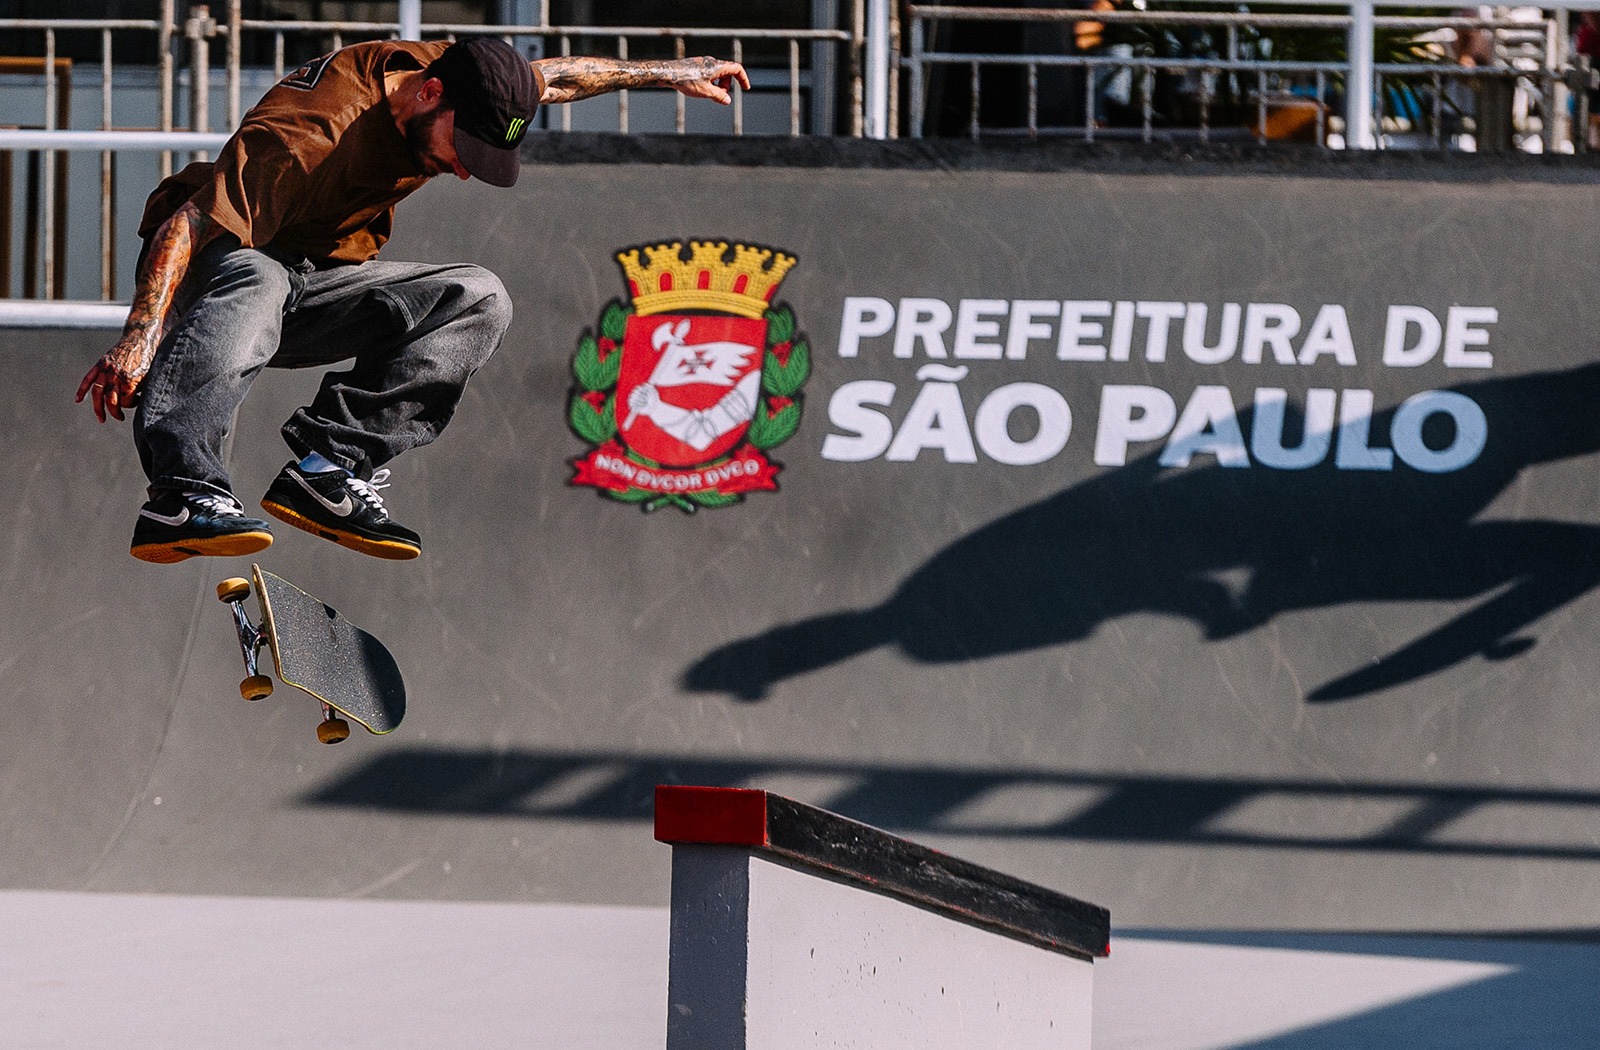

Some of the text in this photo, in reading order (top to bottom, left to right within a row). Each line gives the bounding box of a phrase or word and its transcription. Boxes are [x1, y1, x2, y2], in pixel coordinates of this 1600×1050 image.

[838, 297, 1499, 368] PREFEITURA DE
[821, 364, 1488, 473] SÃO PAULO
[595, 455, 635, 480] NON
[635, 470, 702, 490] DVCOR
